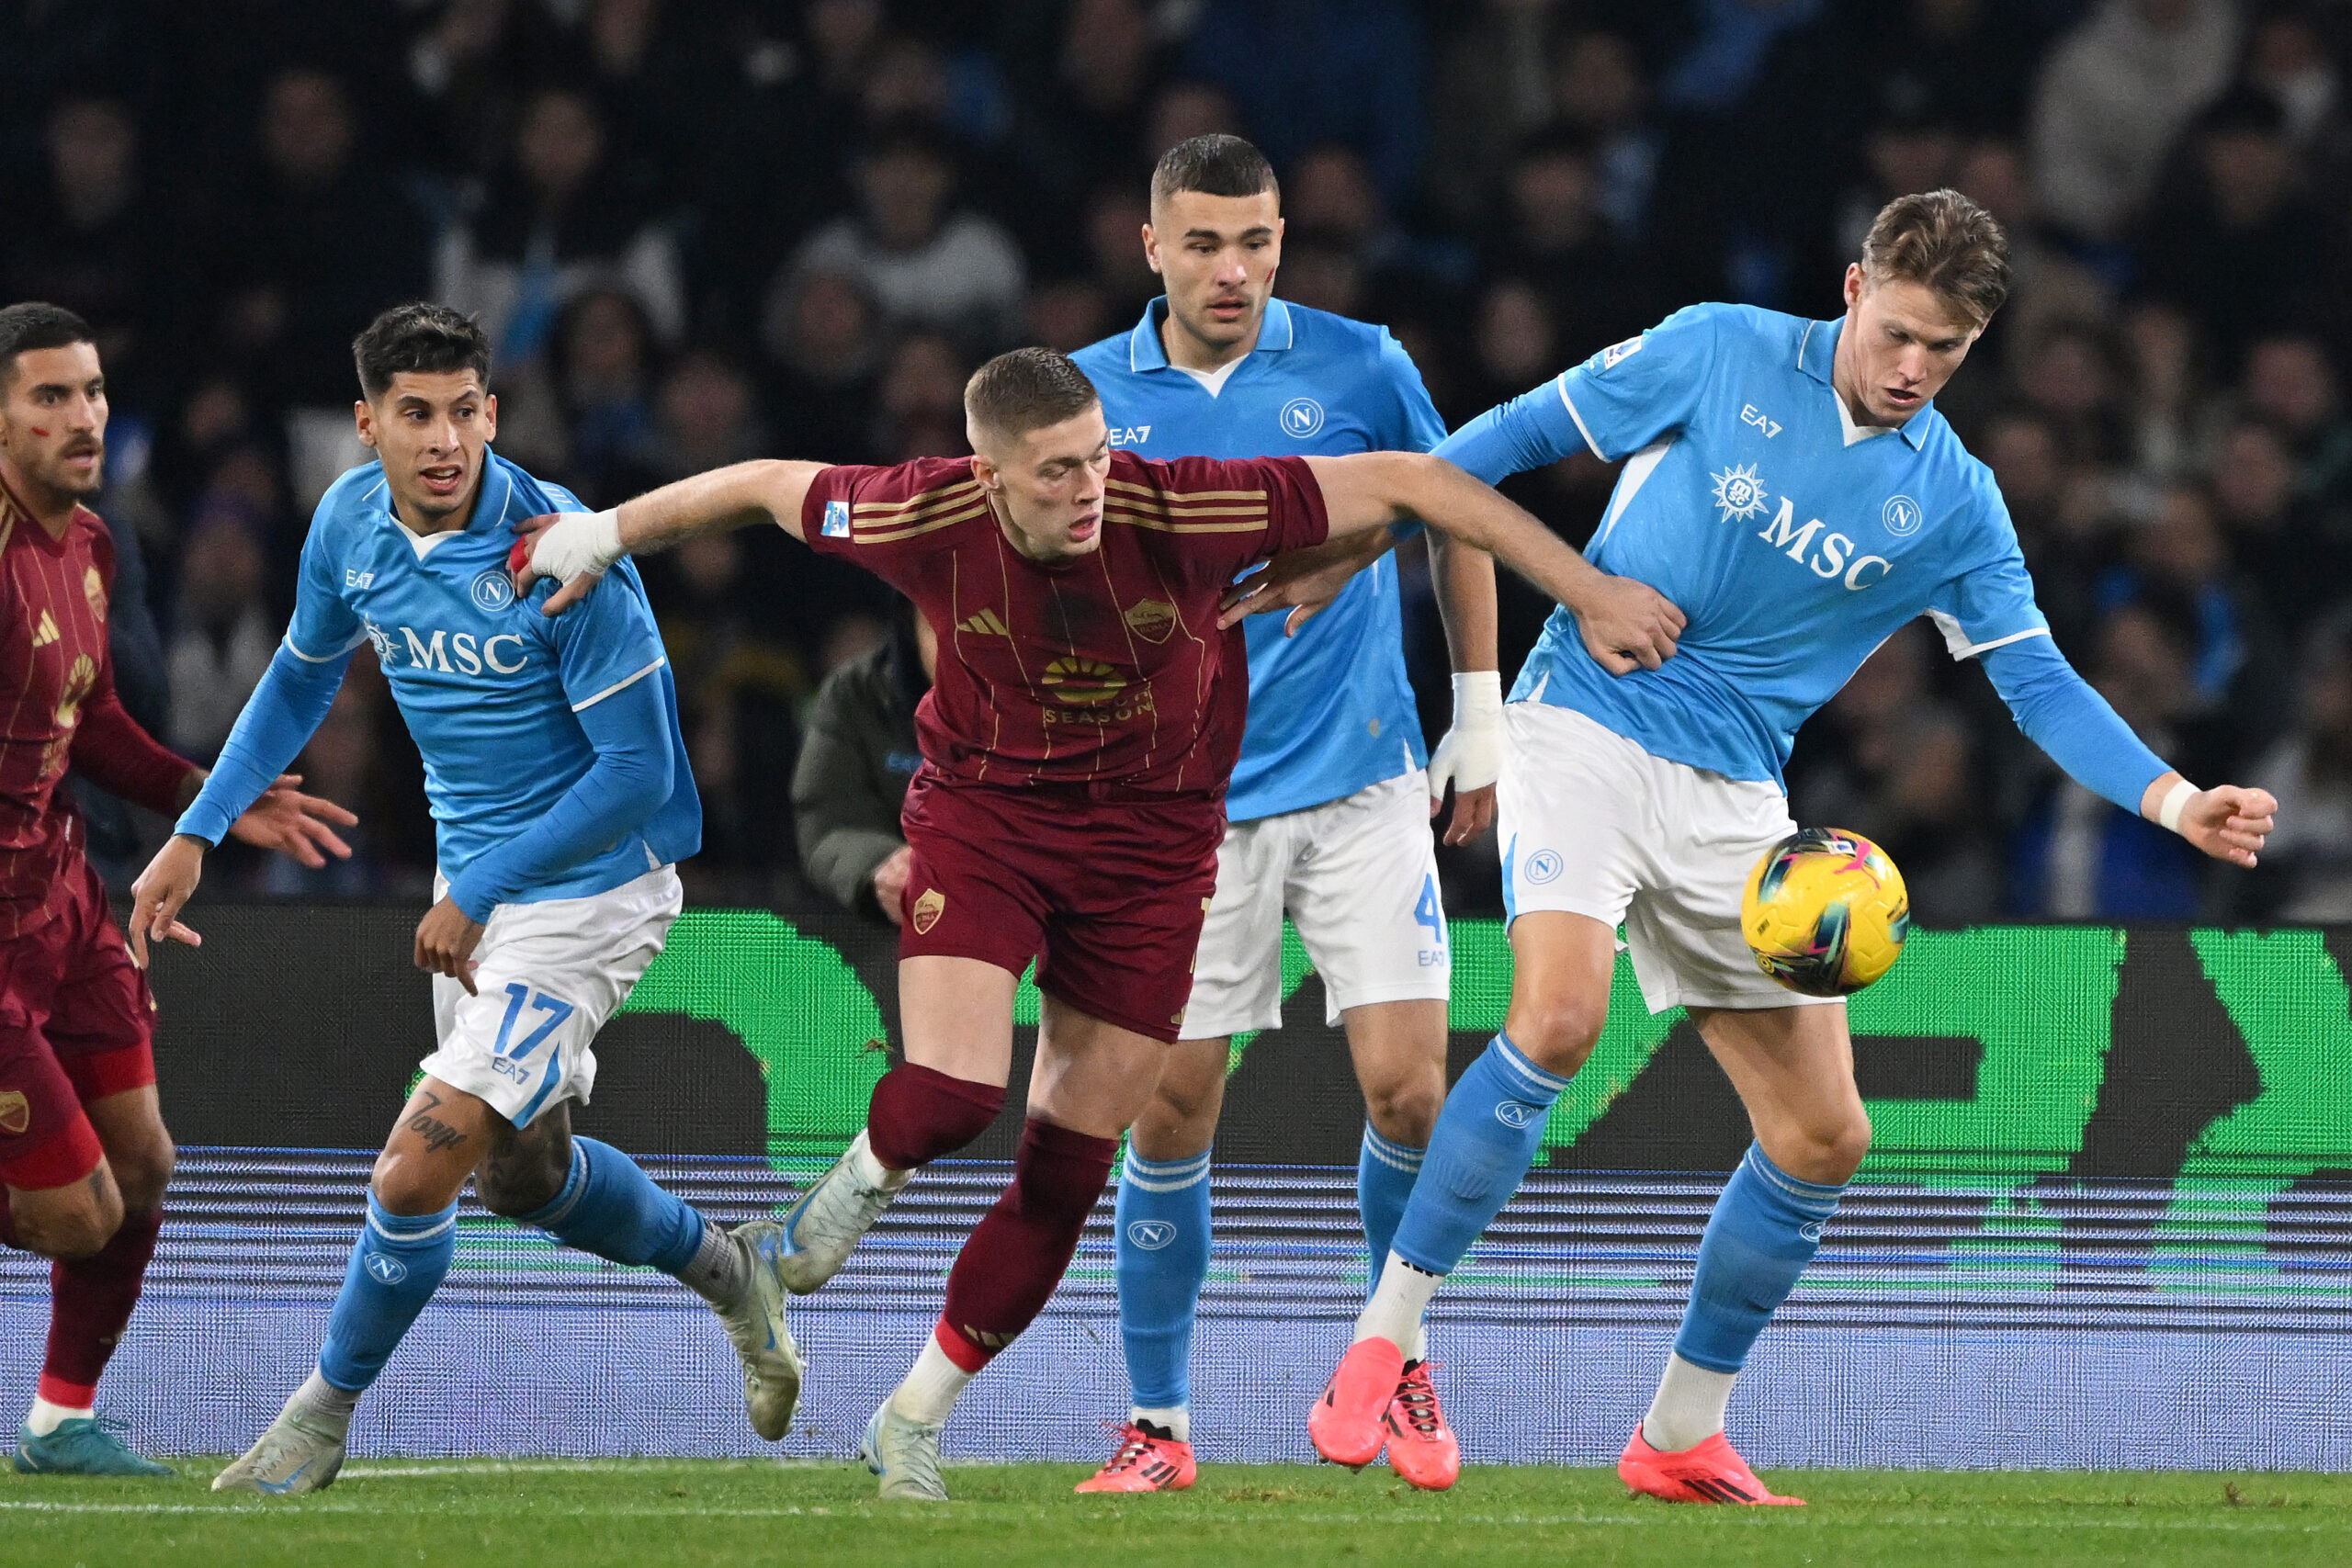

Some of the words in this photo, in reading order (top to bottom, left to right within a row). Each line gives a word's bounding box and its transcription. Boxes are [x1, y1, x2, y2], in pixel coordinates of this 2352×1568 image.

[1109, 425, 1151, 446] EA7
[1740, 403, 1783, 439] EA7
[1758, 495, 1894, 591] MSC
[345, 569, 375, 590] EA7
[399, 626, 528, 675] MSC
[1045, 702, 1154, 725] SEASON
[1413, 872, 1442, 944] 4
[492, 982, 575, 1062] 17
[491, 1056, 530, 1086] EA7
